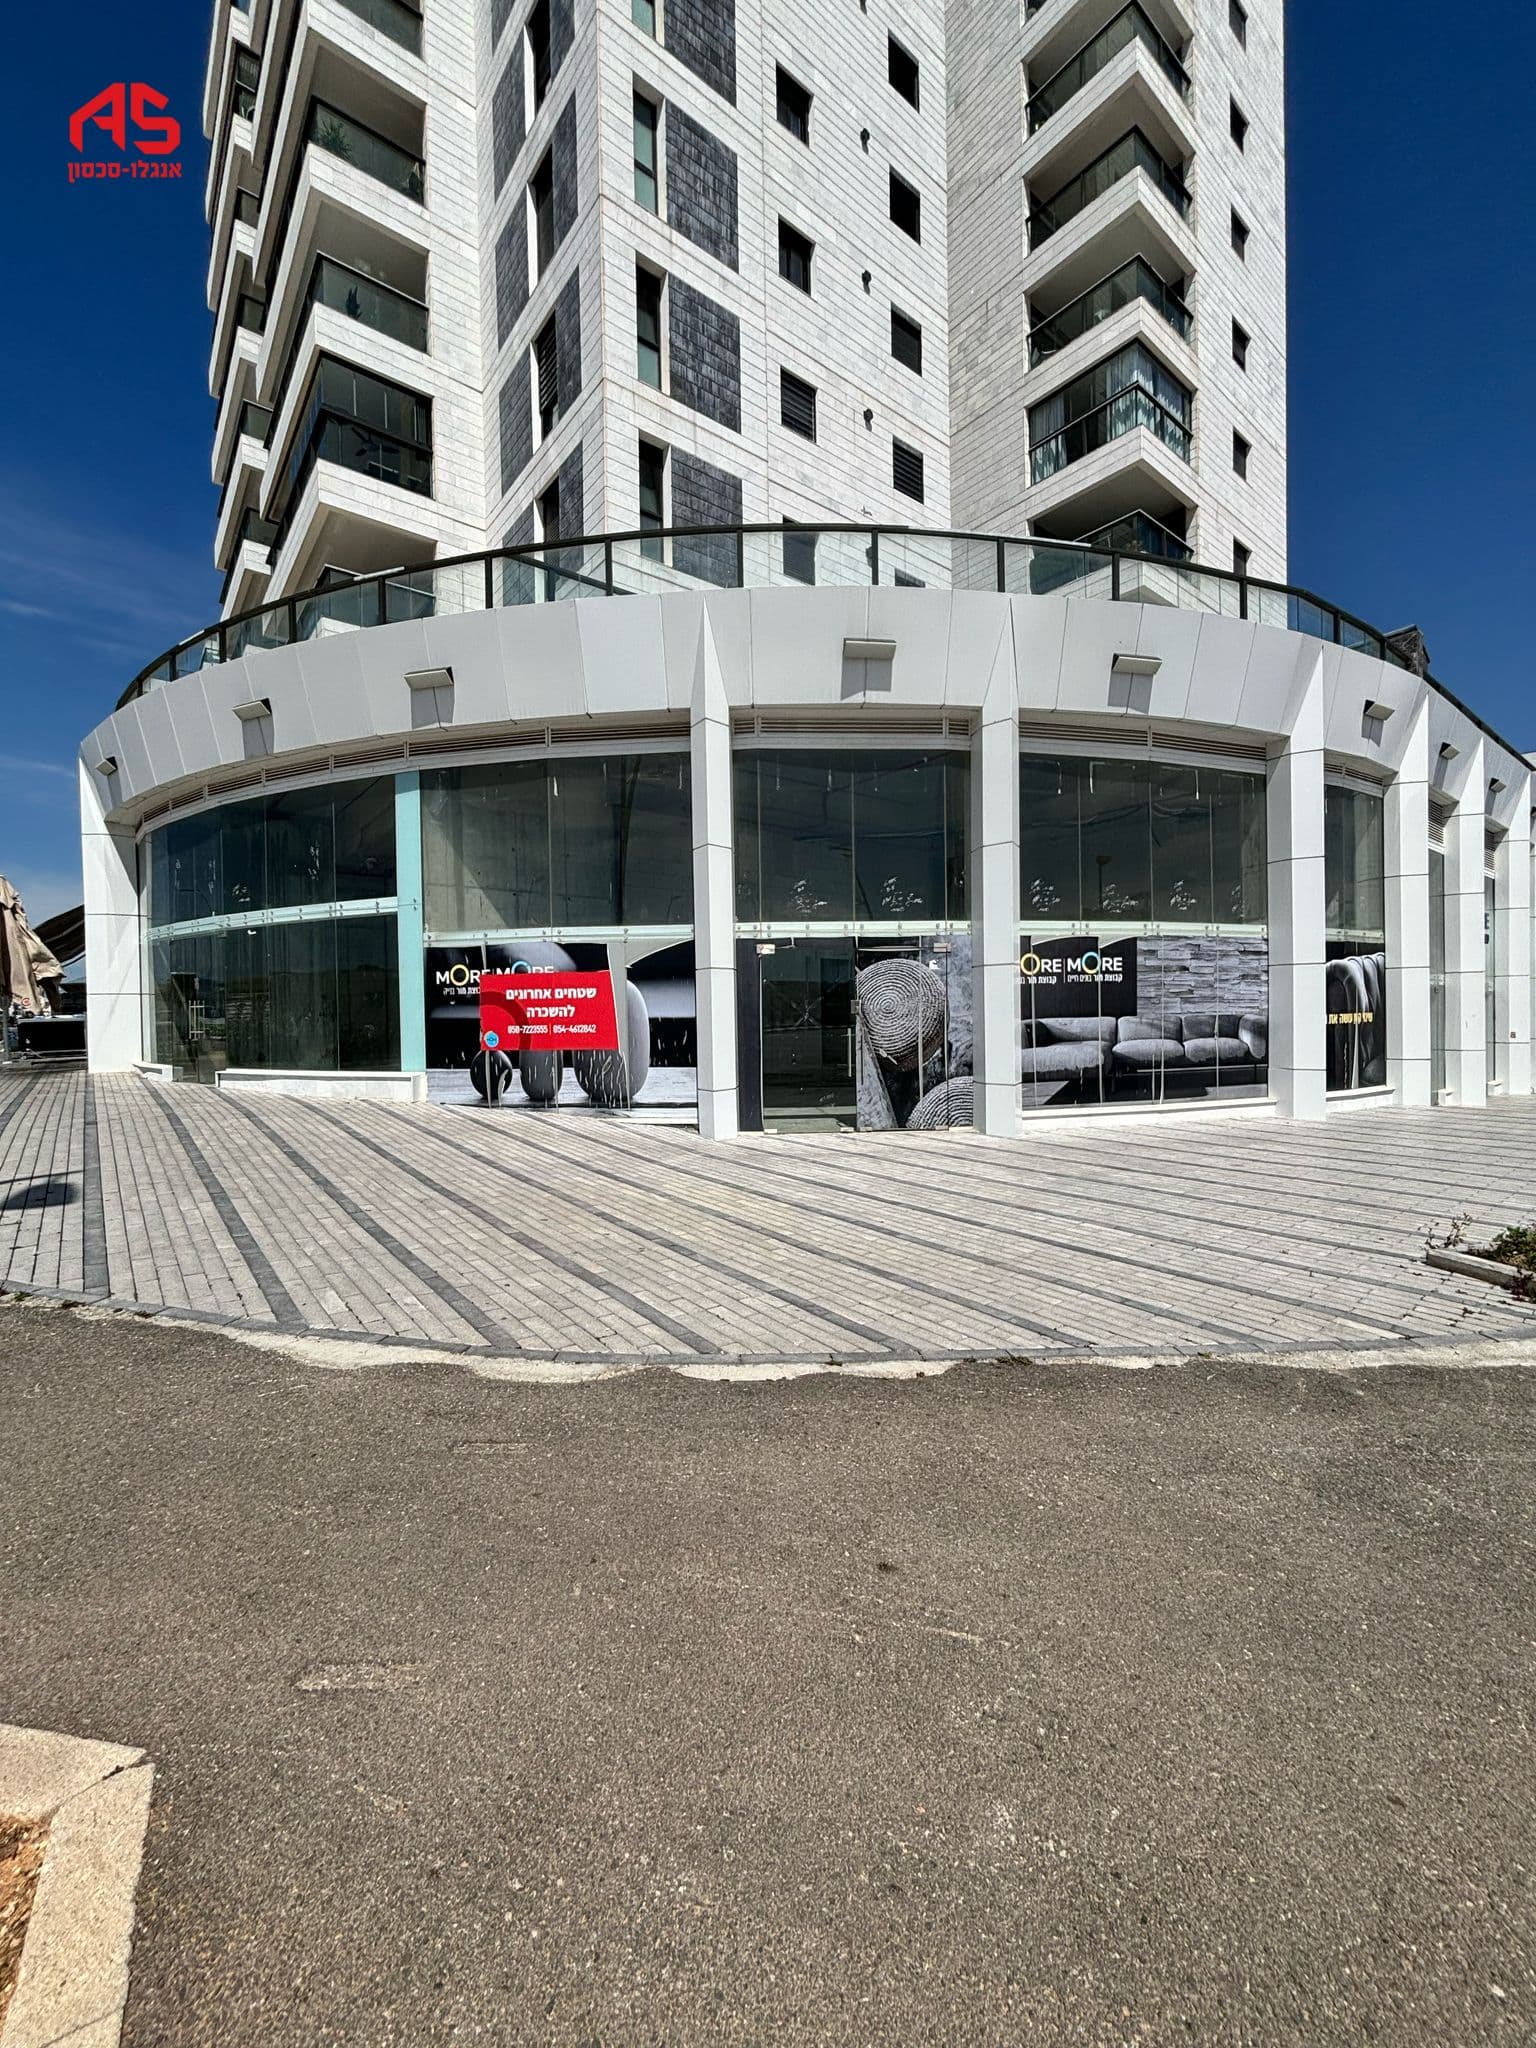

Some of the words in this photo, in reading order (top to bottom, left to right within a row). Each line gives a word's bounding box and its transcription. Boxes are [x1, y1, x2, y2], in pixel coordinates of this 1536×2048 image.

[1020, 953, 1062, 976] ORE
[1067, 951, 1123, 974] MORE
[505, 988, 552, 1000] אחרונים
[554, 988, 597, 999] שטחים
[526, 1004, 576, 1018] להשכרה
